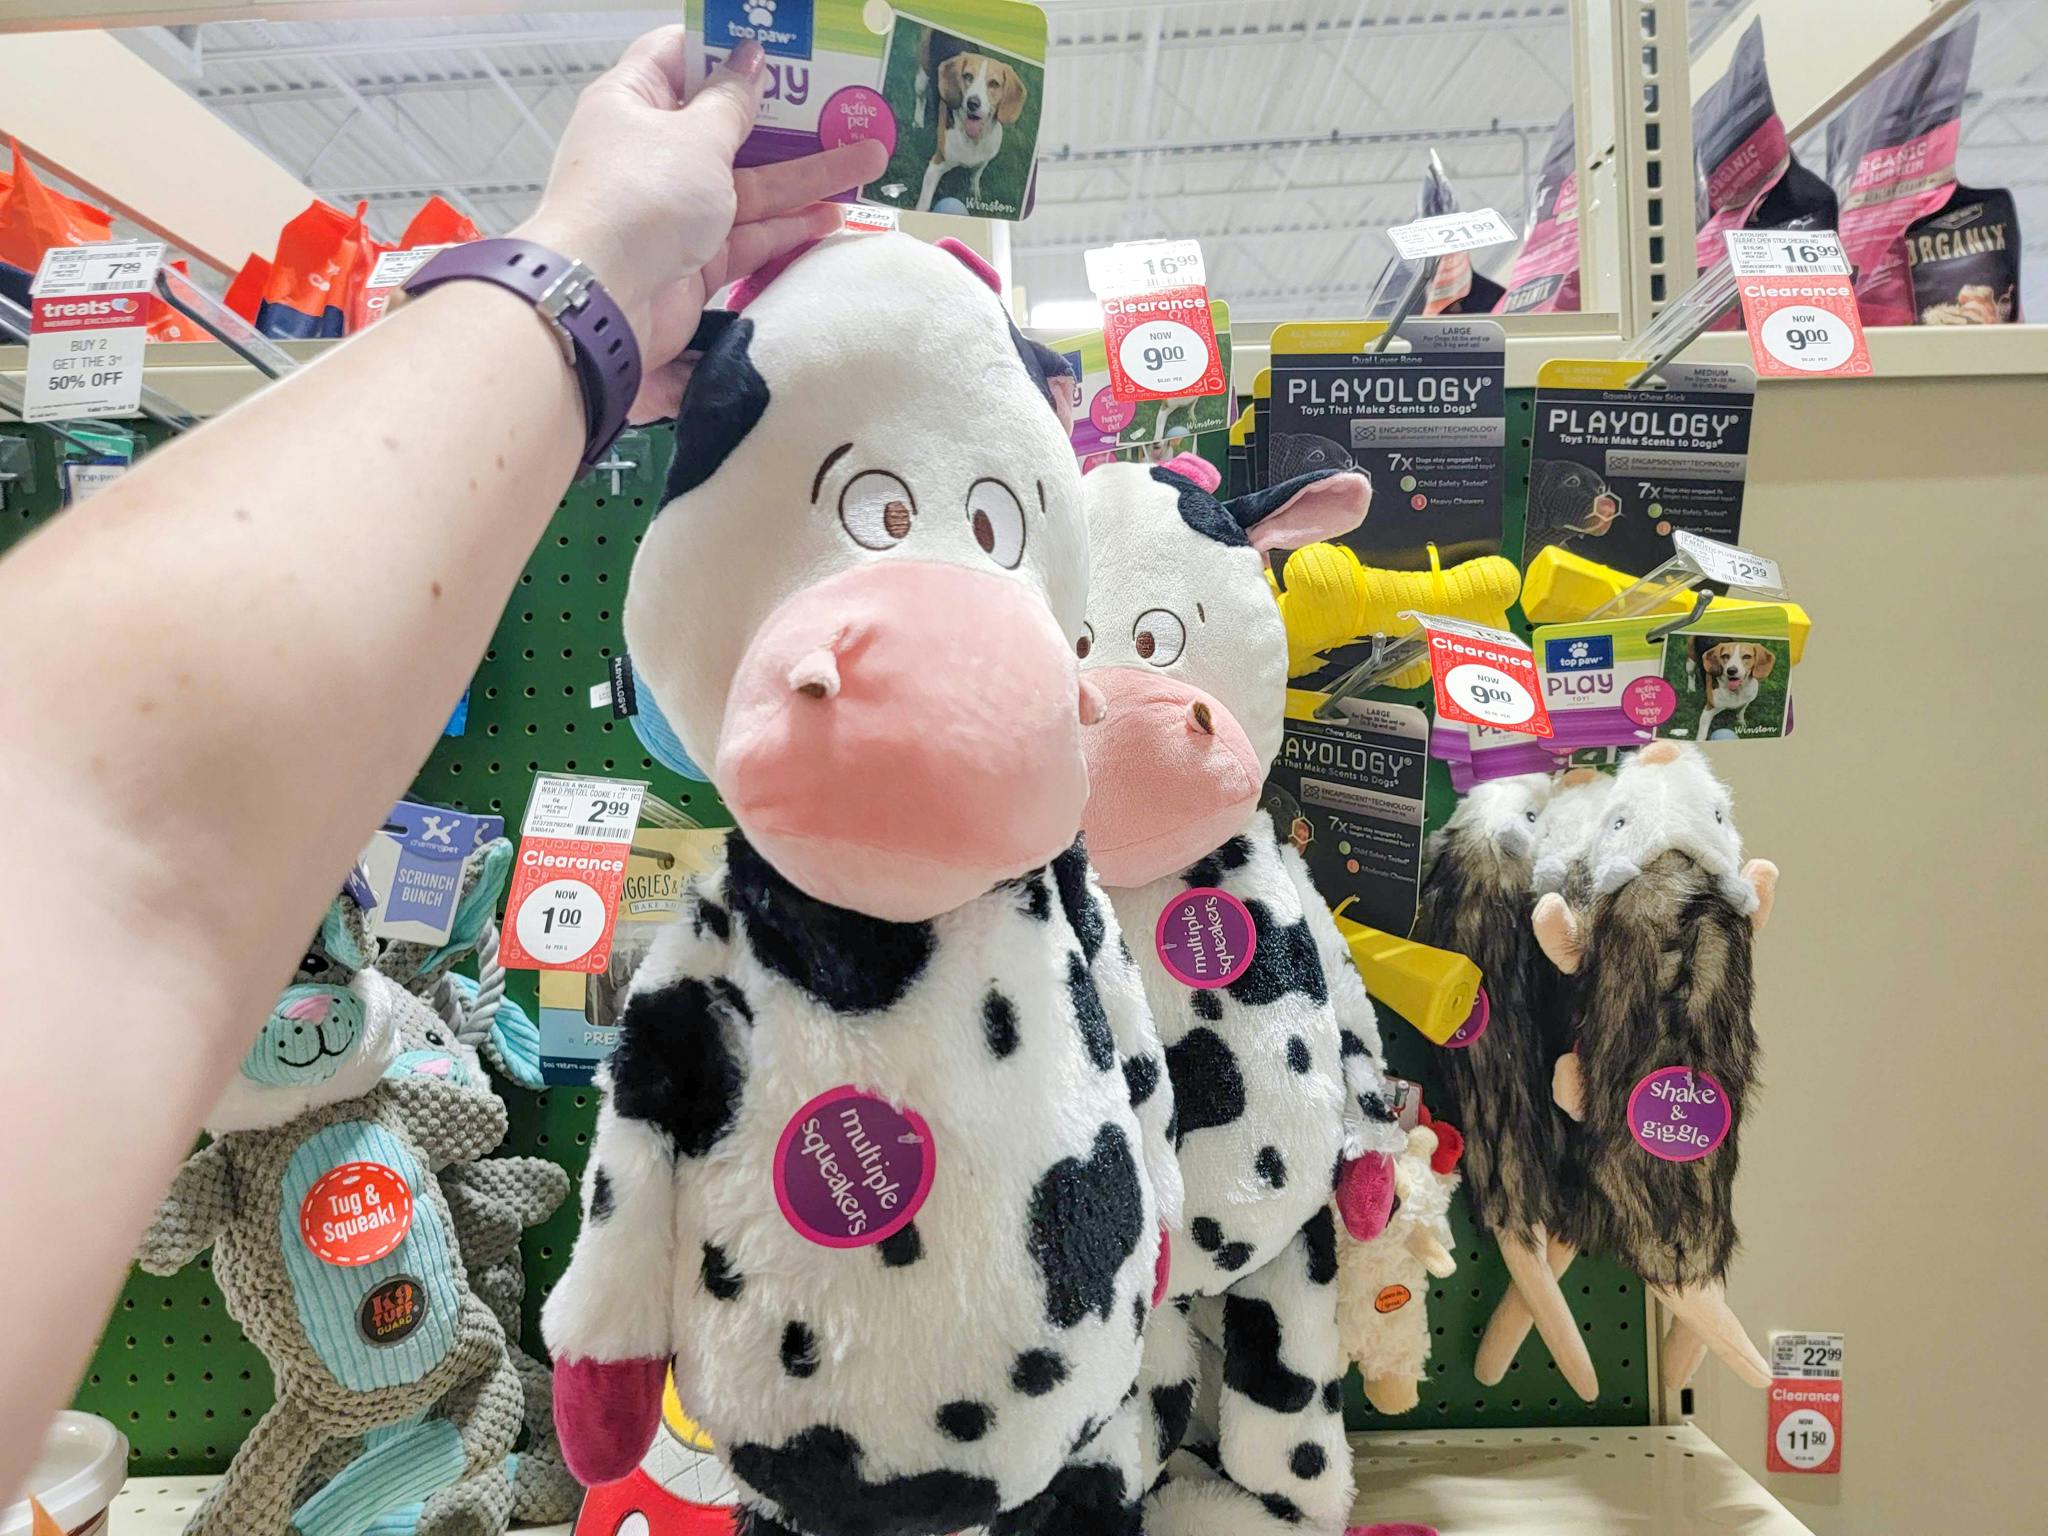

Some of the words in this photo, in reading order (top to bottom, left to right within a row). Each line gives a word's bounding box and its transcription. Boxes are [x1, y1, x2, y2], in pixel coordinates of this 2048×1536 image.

[840, 103, 877, 116] active
[848, 116, 869, 128] pet
[965, 196, 1016, 213] Winston
[1744, 285, 1850, 298] Clearance
[42, 300, 111, 318] treats
[1103, 297, 1206, 315] Clearance
[1149, 331, 1173, 341] NOW
[70, 339, 96, 351] BUY
[99, 339, 108, 350] 2
[52, 358, 77, 370] GET
[81, 355, 105, 368] THE
[1352, 356, 1372, 364] Dual
[1400, 356, 1423, 364] Bone
[1694, 369, 1729, 377] MEDIUM
[48, 373, 86, 390] 50%
[91, 371, 123, 387] OFF
[1664, 393, 1686, 401] Stick
[1300, 406, 1325, 417] Toys
[1328, 405, 1352, 415] That
[1356, 405, 1385, 414] Make
[1389, 405, 1425, 414] Scents
[1429, 404, 1440, 413] to
[1186, 418, 1223, 430] Winston
[1559, 434, 1583, 445] Toys
[1586, 435, 1609, 445] That
[1611, 435, 1638, 445] Make
[1641, 436, 1675, 447] Scents
[1679, 438, 1689, 447] to
[1387, 453, 1414, 471] 7x
[1439, 480, 1460, 488] Safety
[1638, 482, 1661, 499] 7x
[1430, 498, 1451, 506] Heavy
[1432, 637, 1532, 669] Clearance
[1560, 658, 1577, 667] top
[1477, 674, 1500, 684] NOW
[1635, 685, 1661, 694] active
[1640, 692, 1656, 701] pet
[1366, 708, 1391, 717] LARGE
[1635, 705, 1662, 717] happy
[1642, 716, 1657, 726] pet
[1325, 728, 1344, 737] Chew
[1346, 730, 1362, 740] Stick
[1734, 725, 1777, 734] Winston
[1285, 759, 1301, 769] That
[1304, 763, 1326, 774] Make
[1328, 767, 1357, 780] Scents
[1360, 772, 1369, 782] to
[543, 780, 569, 788] WIGGLES
[563, 788, 589, 797] PRETZEL
[589, 790, 611, 798] COOKIE
[1329, 815, 1348, 834] 7x
[522, 850, 624, 872] Clearance
[398, 868, 455, 891] SCRUNCH
[402, 886, 443, 907] BUNCH
[554, 890, 578, 900] NOW
[1182, 905, 1209, 974] multiple
[1205, 896, 1235, 975] squeakers
[543, 1061, 555, 1069] DOG
[1650, 1080, 1716, 1104] shake
[1670, 1104, 1688, 1120] &
[1641, 1120, 1710, 1148] giggle
[840, 1108, 900, 1210] multiple
[801, 1117, 867, 1236] squeakers
[328, 1192, 362, 1216] Tug
[365, 1183, 381, 1206] &
[322, 1202, 398, 1244] Squeak!
[371, 1283, 413, 1314] K9
[372, 1300, 413, 1328] TUFF
[377, 1315, 413, 1336] GUARD
[1772, 1388, 1841, 1402] Clearance
